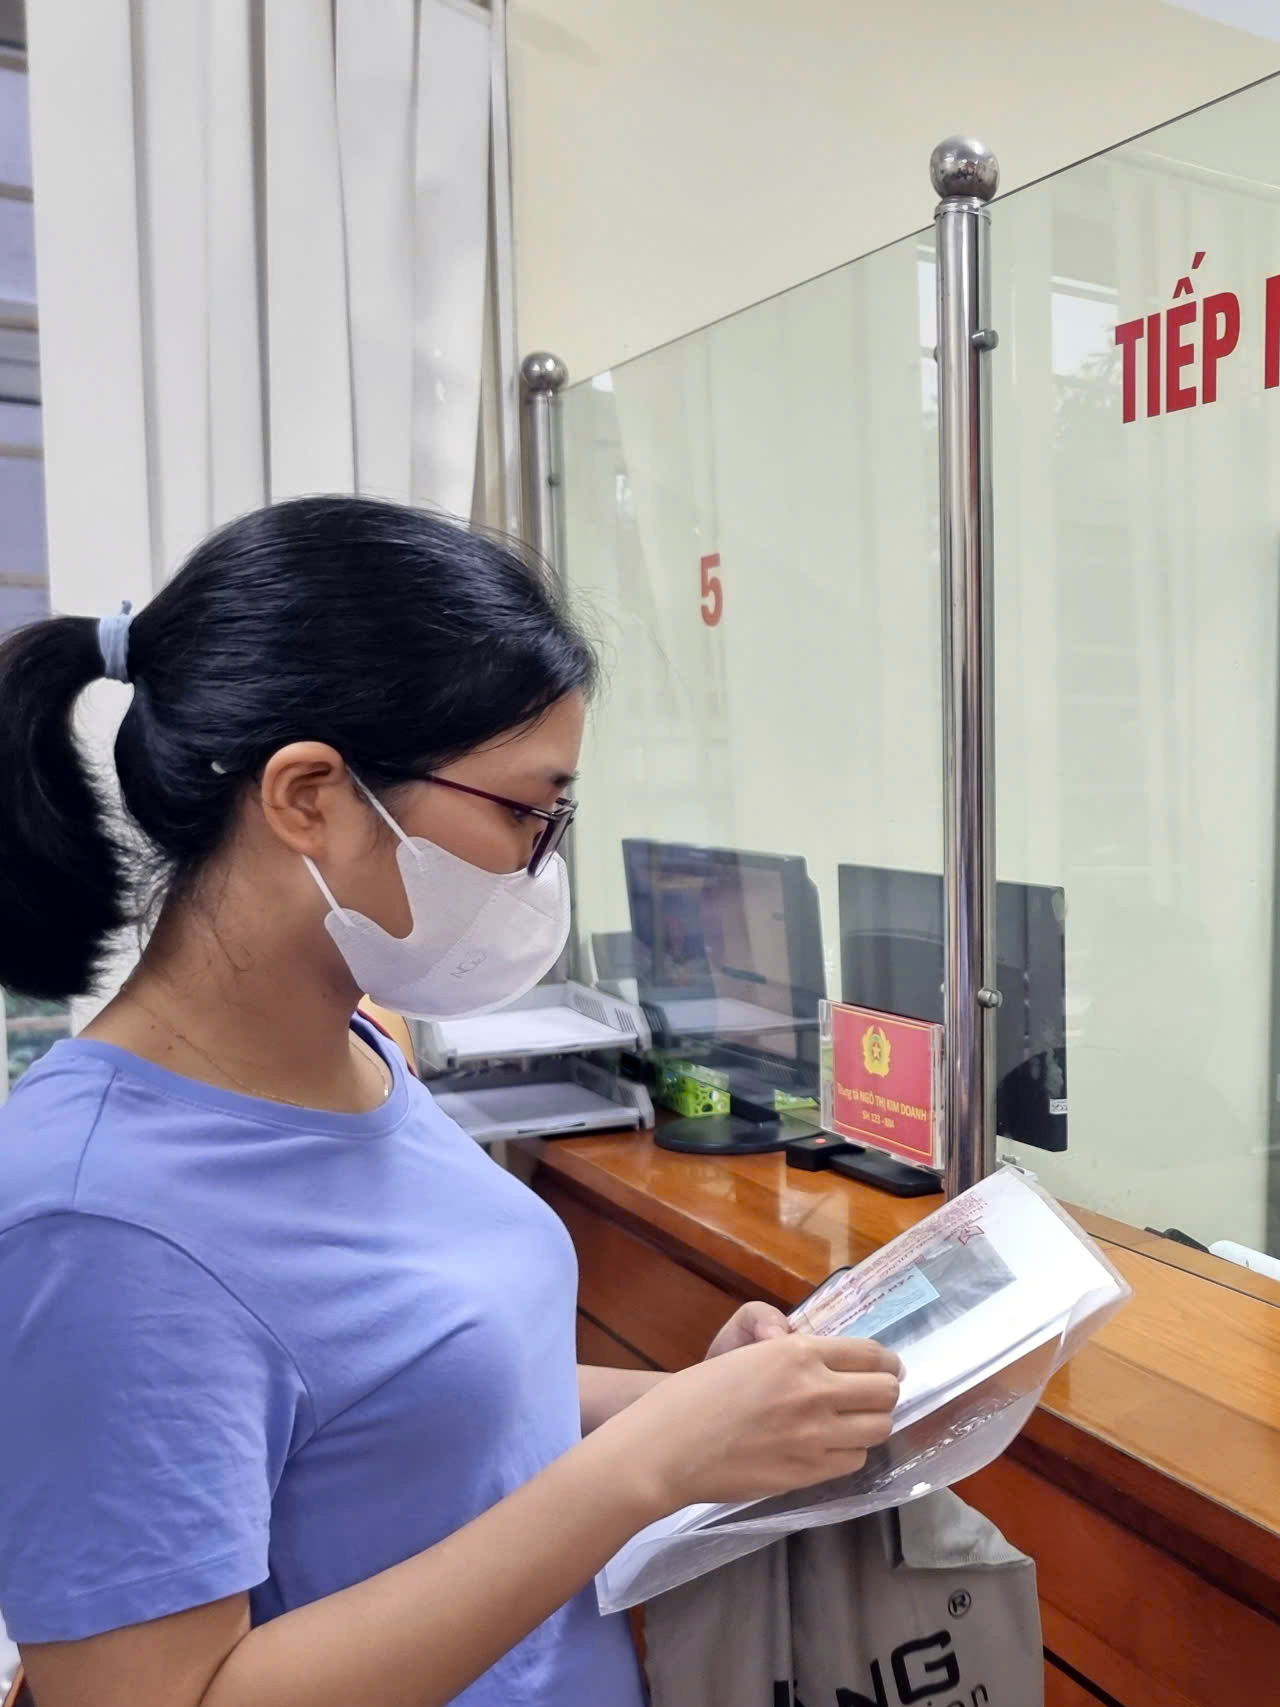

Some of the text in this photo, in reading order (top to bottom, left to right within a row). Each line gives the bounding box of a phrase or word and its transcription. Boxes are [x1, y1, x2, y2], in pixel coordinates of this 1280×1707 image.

[1115, 252, 1240, 423] TIẾP
[701, 553, 723, 627] 5
[900, 1102, 927, 1121] DOANH
